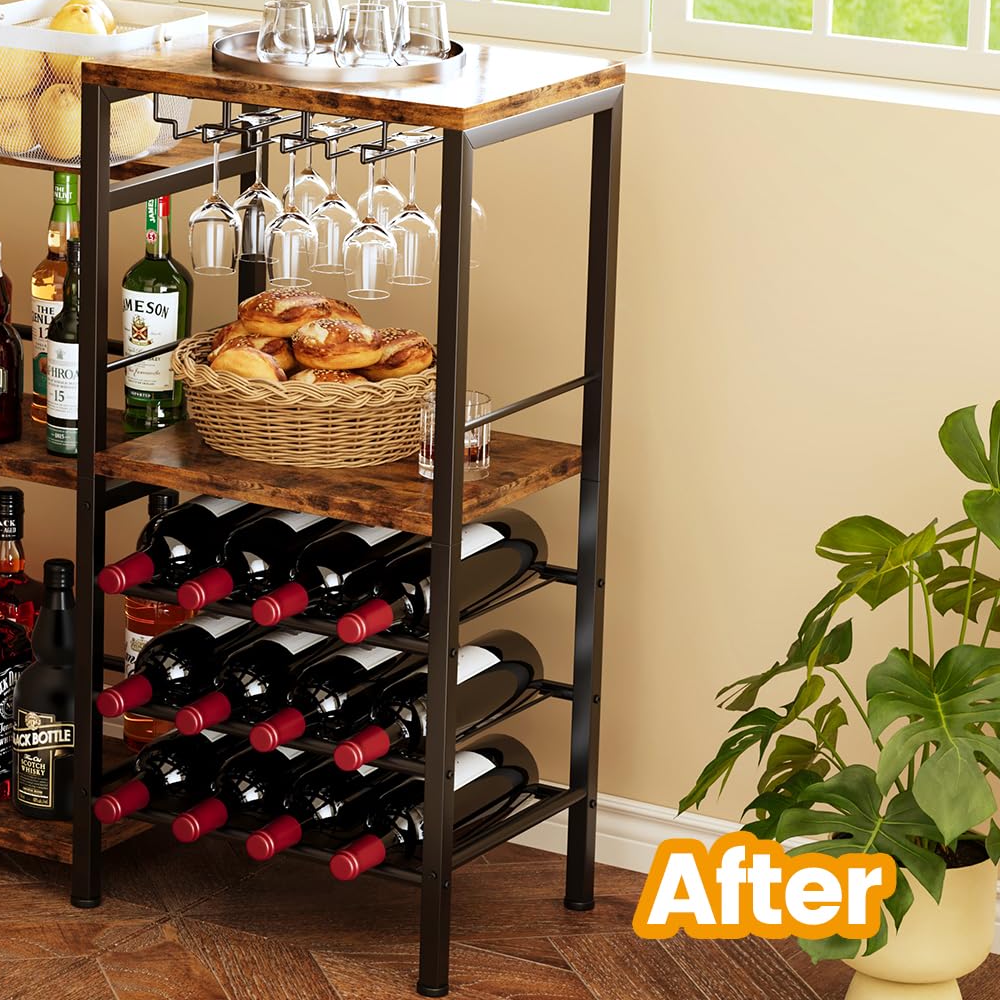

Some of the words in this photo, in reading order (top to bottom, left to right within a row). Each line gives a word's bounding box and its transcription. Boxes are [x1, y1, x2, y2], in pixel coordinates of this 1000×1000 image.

[36, 304, 56, 316] THE
[53, 388, 66, 402] 15
[31, 729, 72, 746] BOTTLE
[21, 758, 46, 770] SCOTCH
[21, 765, 46, 776] WHISKY
